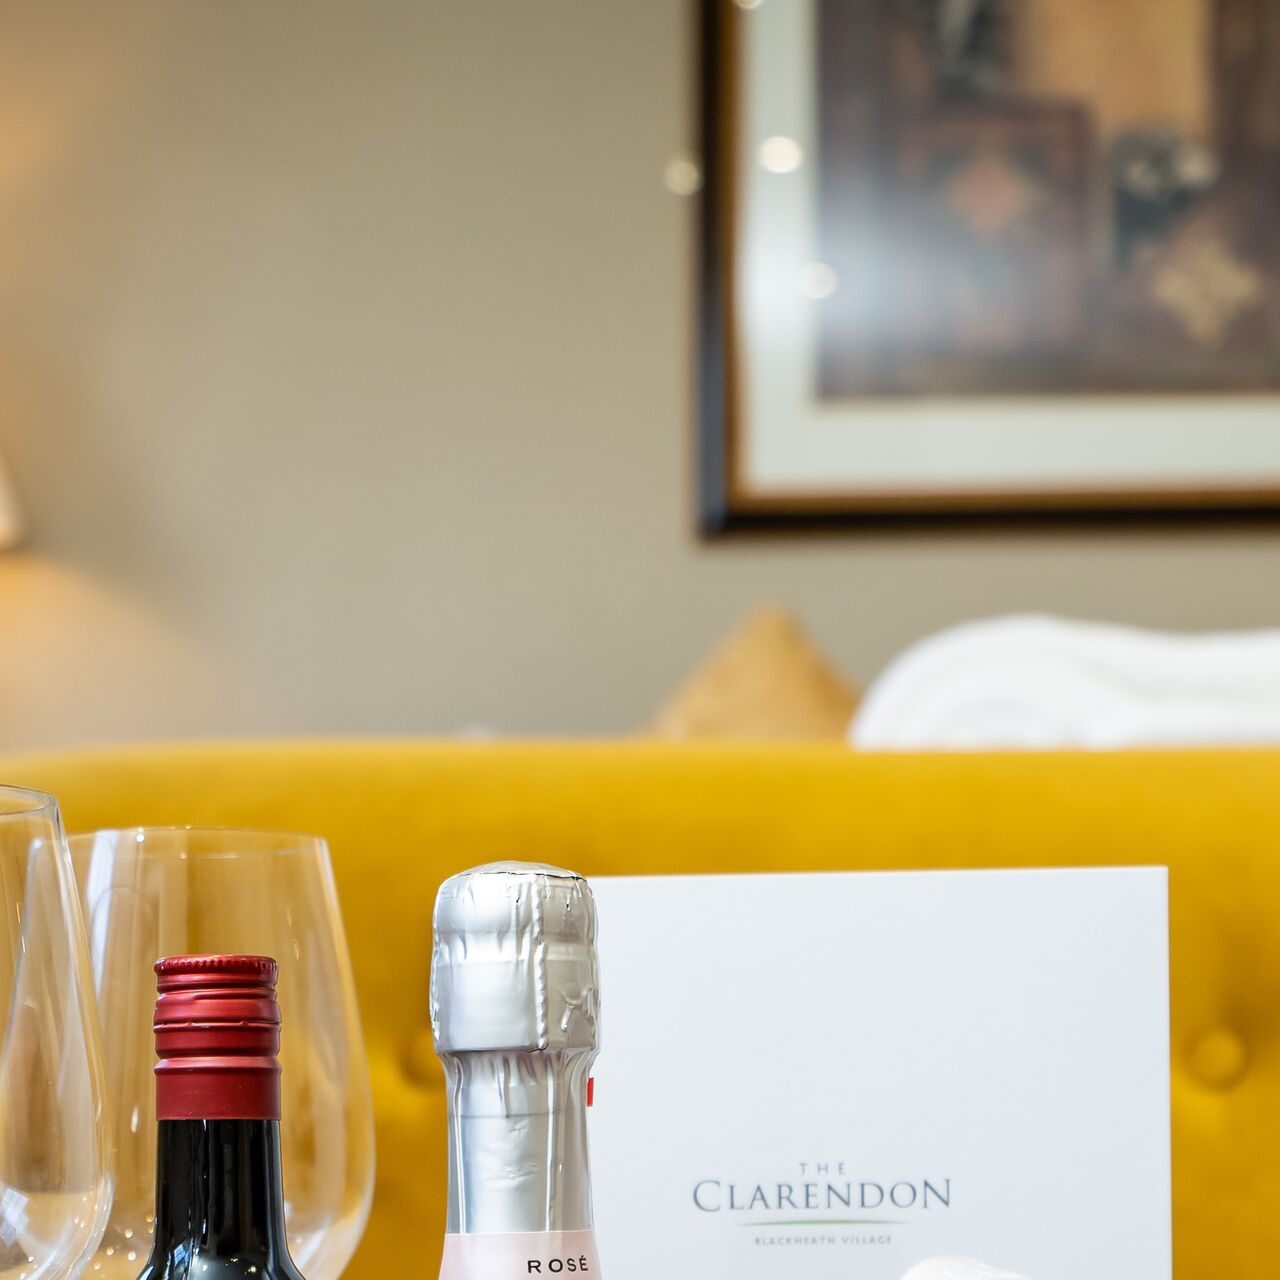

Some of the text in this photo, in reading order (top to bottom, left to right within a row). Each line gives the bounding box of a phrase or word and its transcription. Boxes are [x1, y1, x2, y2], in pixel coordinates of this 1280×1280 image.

[799, 1162, 846, 1176] THE
[692, 1178, 952, 1213] CLARENDON
[755, 1235, 893, 1247] BLACKHEATH VILLAGE
[527, 1255, 589, 1274] ROSÉ
